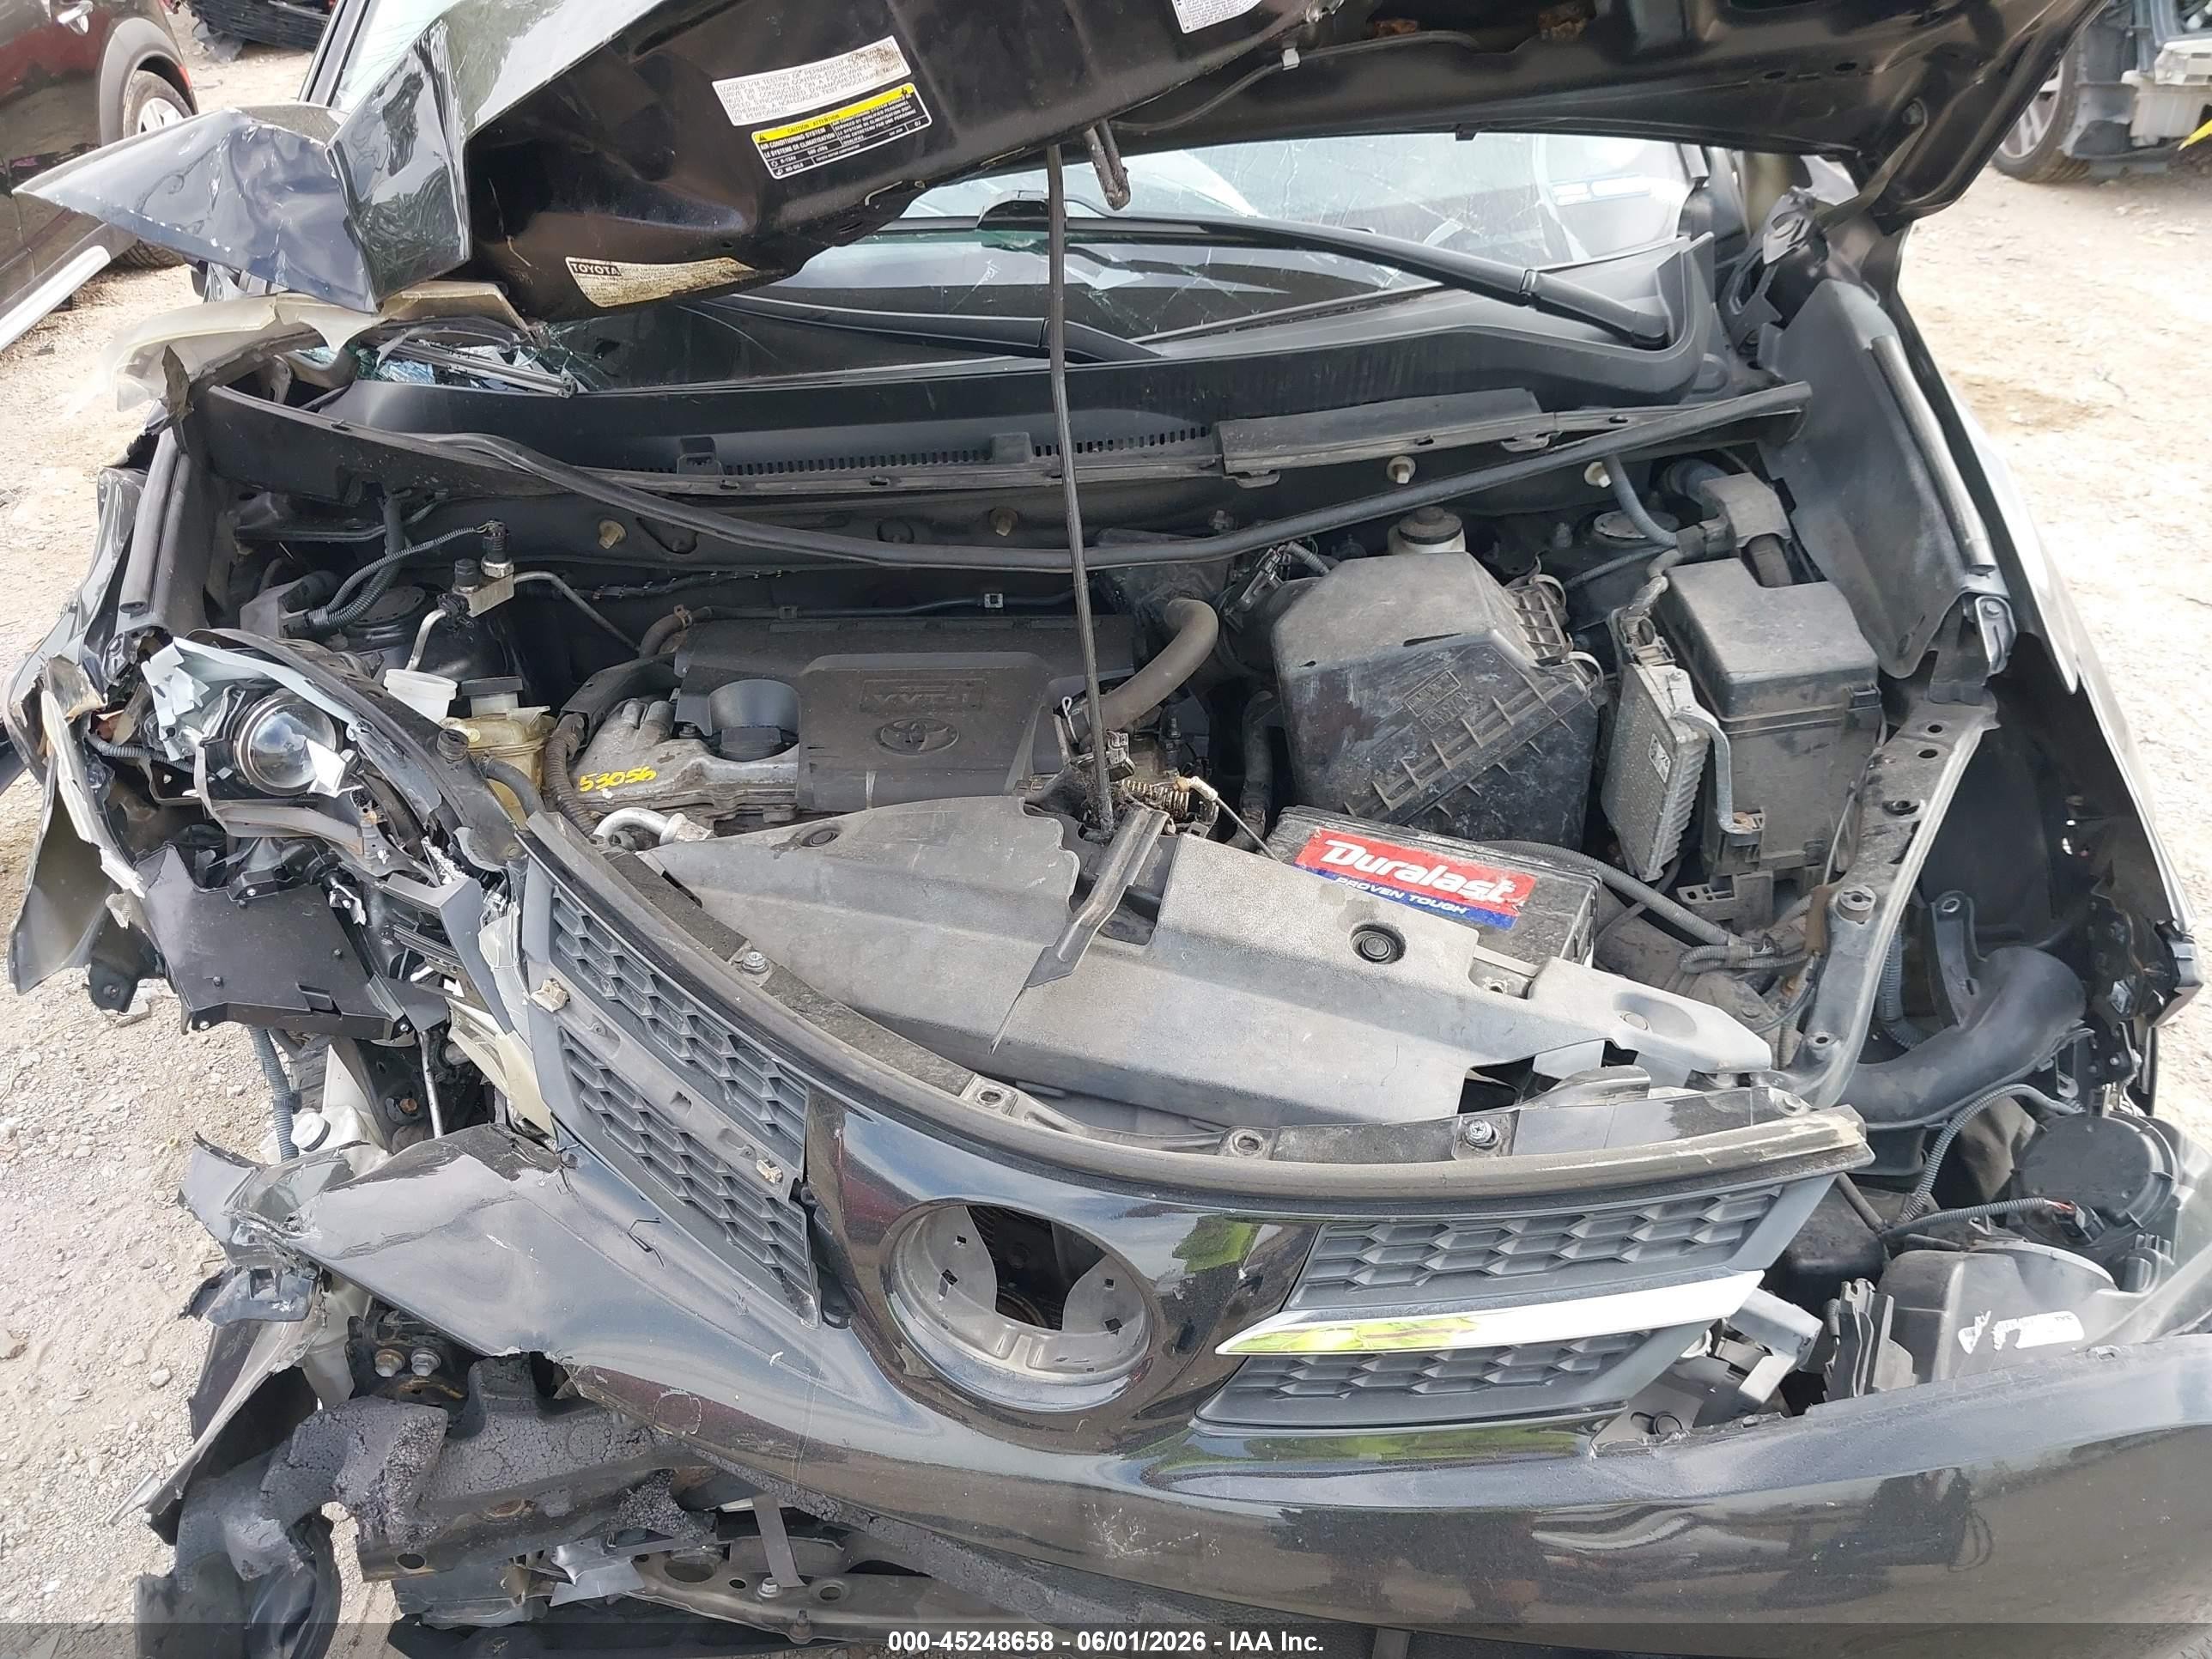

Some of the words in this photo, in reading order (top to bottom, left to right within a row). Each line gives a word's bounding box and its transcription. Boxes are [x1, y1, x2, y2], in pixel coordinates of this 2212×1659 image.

[763, 75, 788, 84] TESTING
[804, 61, 843, 76] PERMANENT
[757, 81, 788, 92] TRACTION
[862, 108, 883, 122] QUALIFIED
[884, 98, 907, 113] PERSONNEL
[787, 124, 808, 133] CAUTION
[812, 113, 839, 126] ATTENTION
[769, 133, 804, 148] CONDITIONING
[805, 126, 825, 138] SYSTEM
[799, 131, 834, 148] CLIMATISATION
[570, 264, 619, 275] TOYOTA
[580, 766, 656, 791] 53056
[1320, 839, 1517, 903] Duralast
[1334, 875, 1406, 900] PROVEN
[1409, 894, 1468, 915] TOUGH
